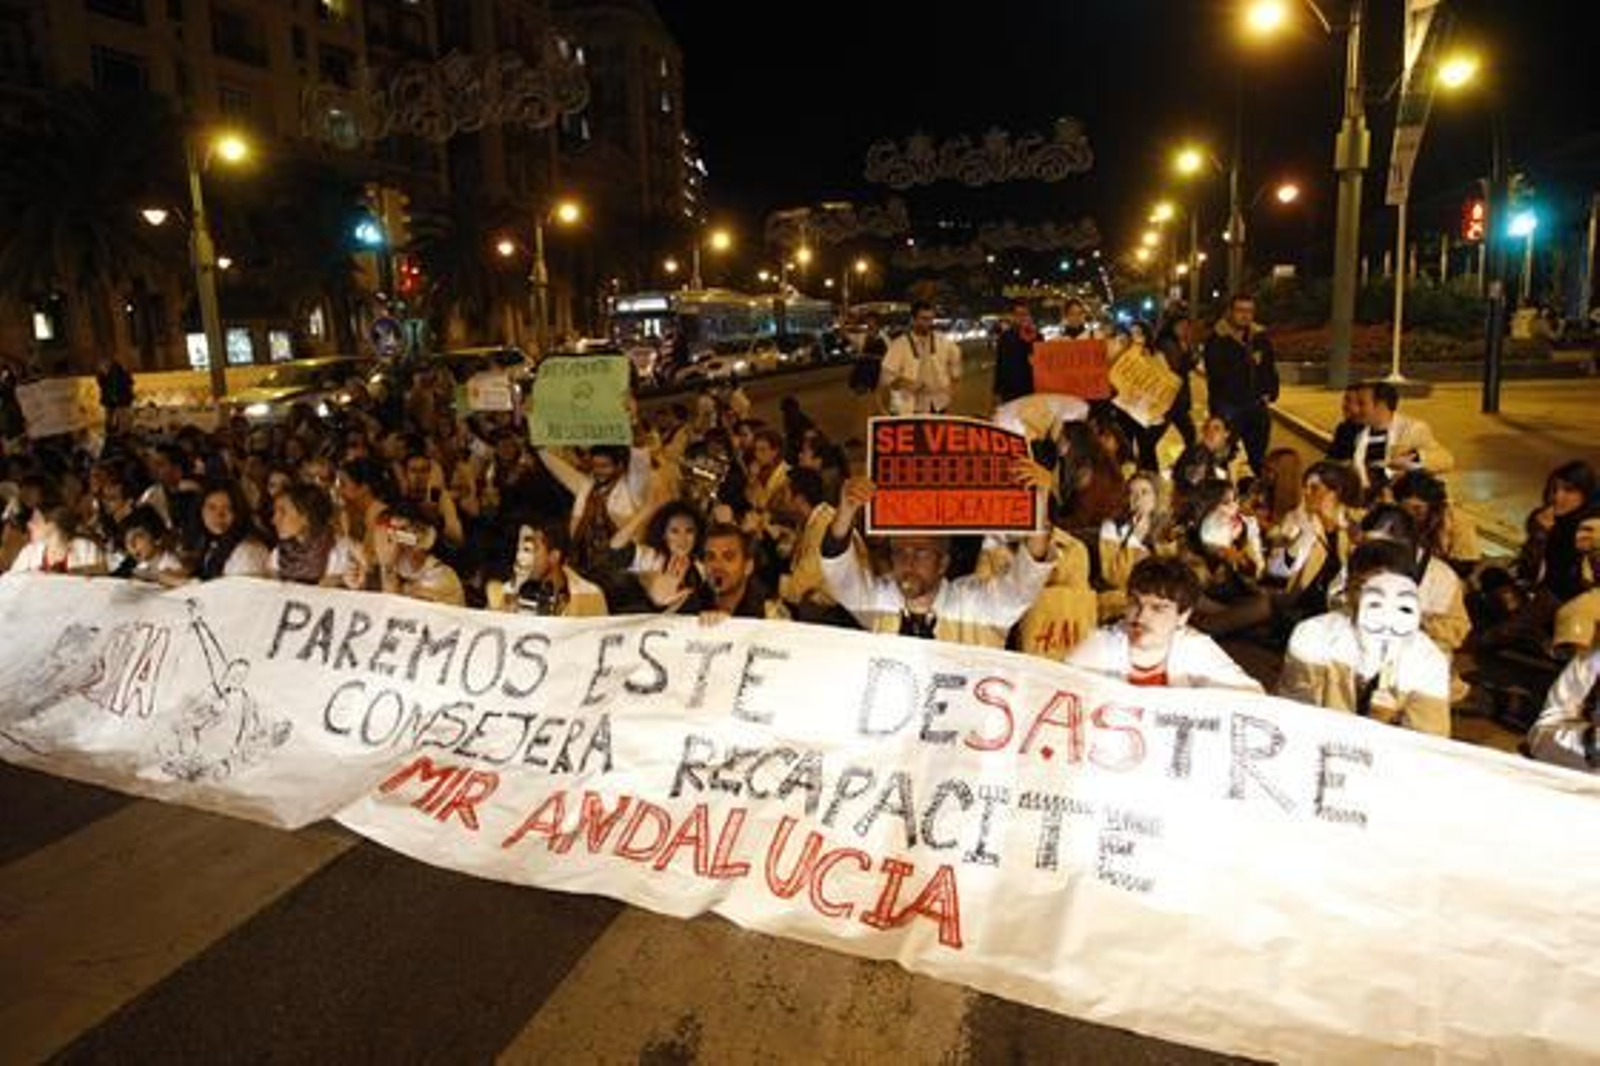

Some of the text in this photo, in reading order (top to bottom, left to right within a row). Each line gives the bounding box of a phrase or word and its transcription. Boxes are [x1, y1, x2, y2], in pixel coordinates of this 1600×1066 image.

[877, 422, 1027, 458] SE VENDE
[266, 600, 551, 698] PAREMOS
[583, 630, 790, 725] ESTE
[858, 656, 1374, 827] DESASTRE
[323, 680, 1162, 893] CONSEJERA RECAPACITE
[379, 756, 963, 950] MIR ANDALUCIA
